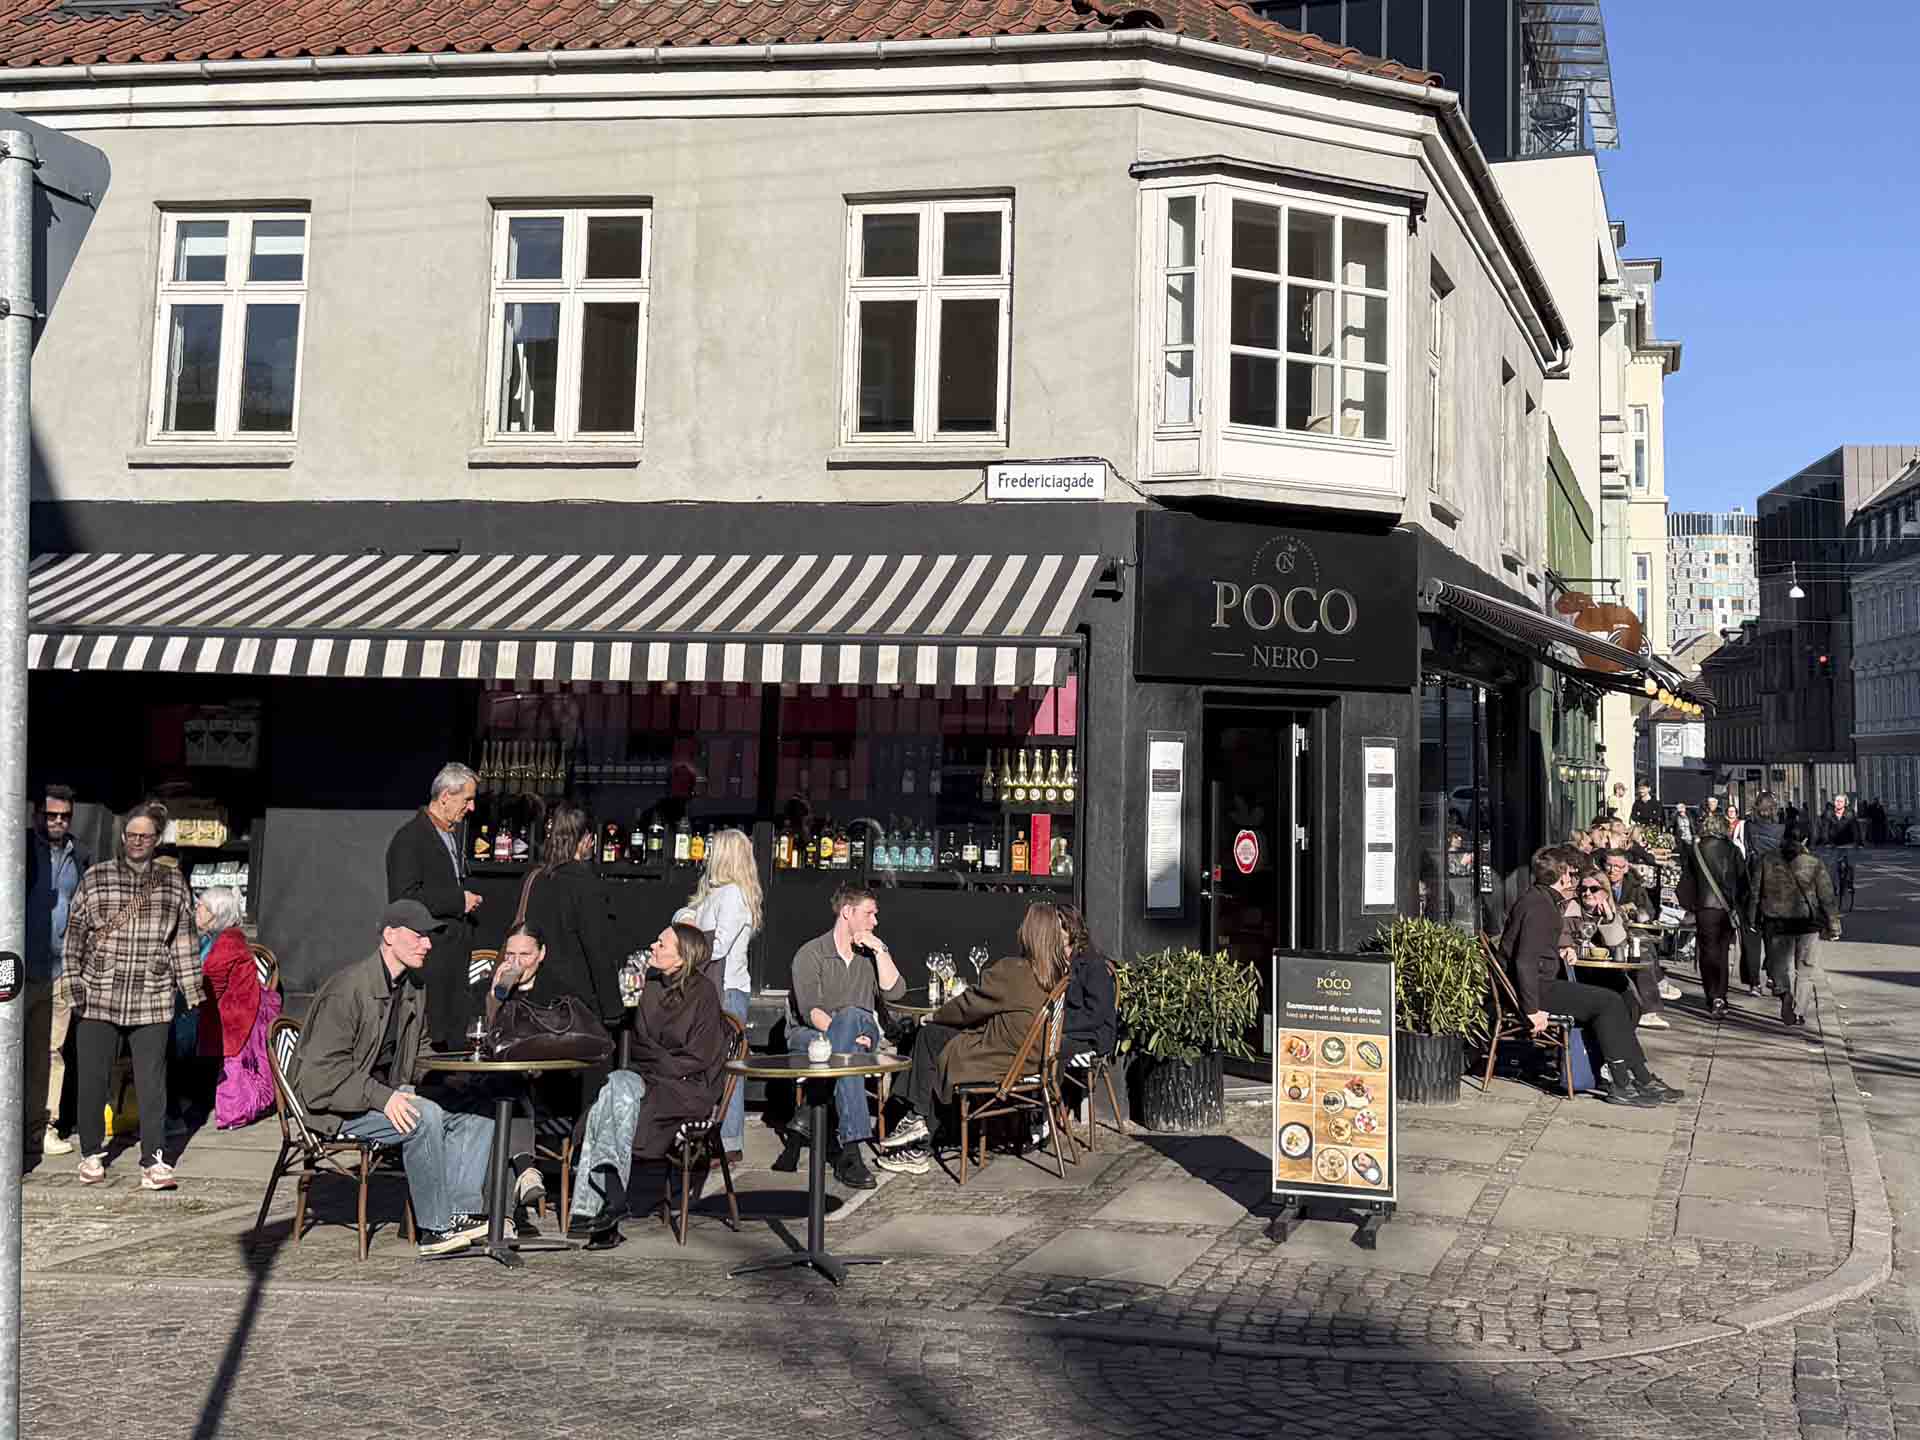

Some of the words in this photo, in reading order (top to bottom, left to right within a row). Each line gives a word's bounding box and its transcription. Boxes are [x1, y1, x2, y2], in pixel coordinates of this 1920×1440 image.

[998, 472, 1094, 492] Fredericiagade
[1211, 580, 1358, 635] POCO
[1252, 645, 1319, 670] NERO
[1317, 977, 1352, 990] POCO
